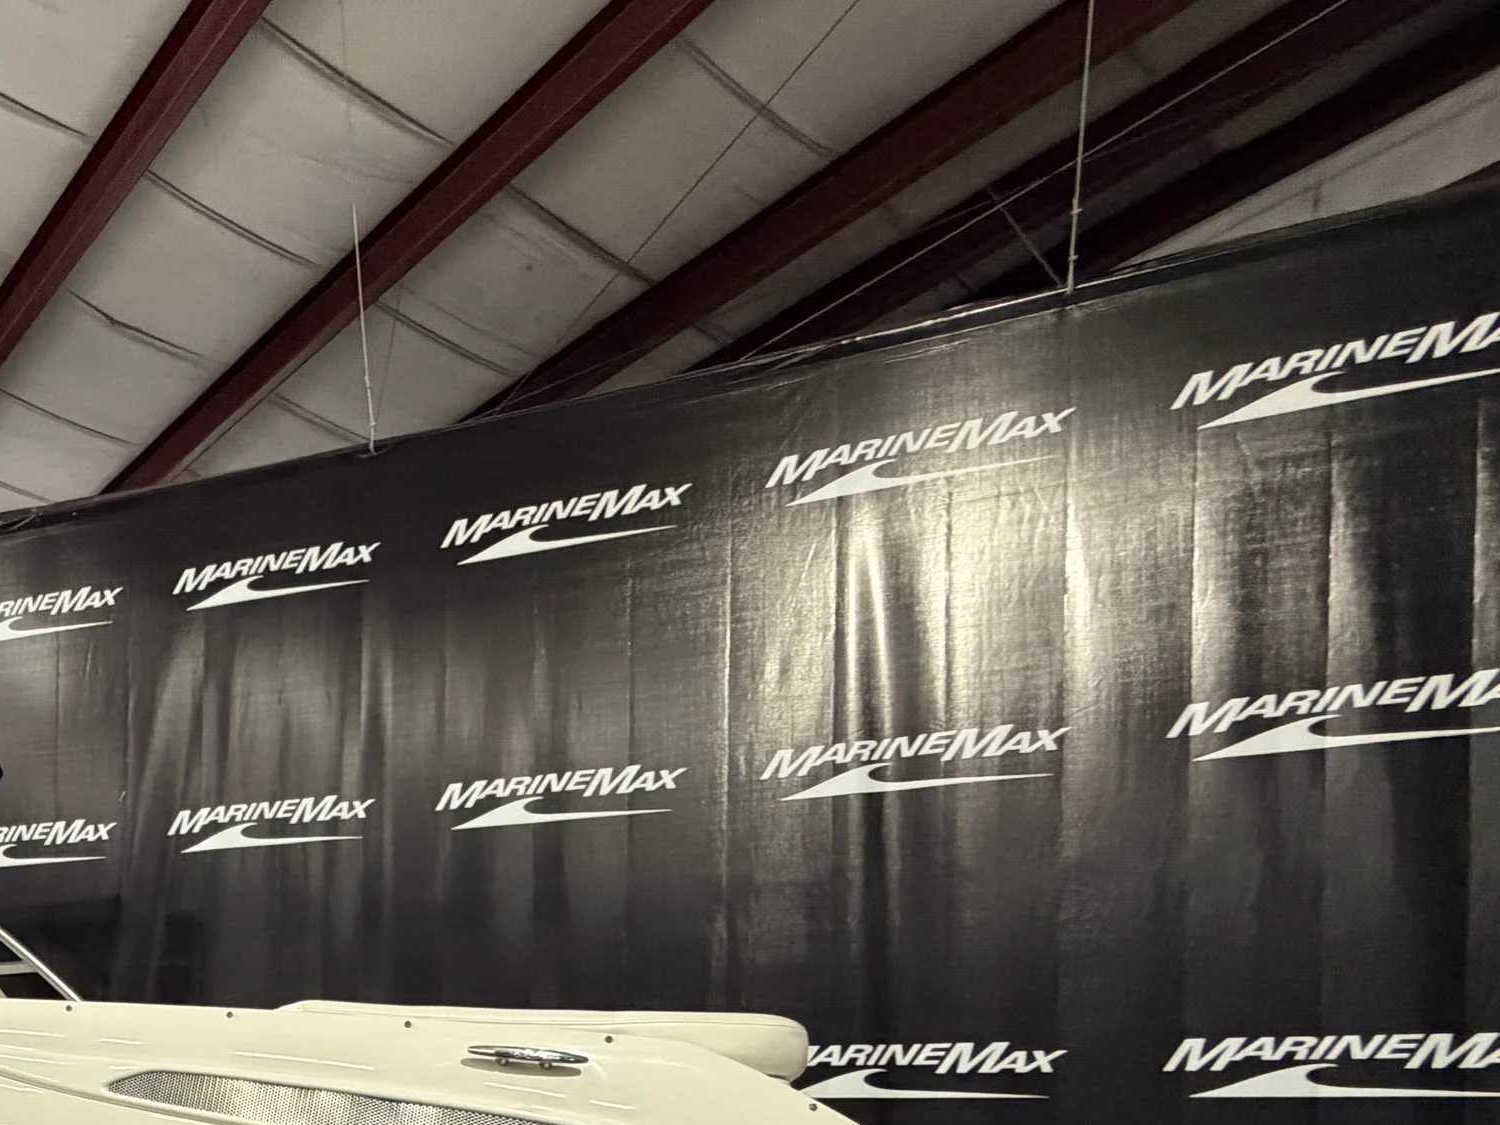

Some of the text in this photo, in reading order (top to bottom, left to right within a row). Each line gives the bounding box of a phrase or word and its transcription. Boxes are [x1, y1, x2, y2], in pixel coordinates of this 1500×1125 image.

[1170, 311, 1500, 410] MARINEM
[764, 406, 1077, 489] MARINEMAX
[439, 482, 694, 549] MARINEMAX
[171, 541, 382, 595] MARINEMAX
[1165, 667, 1500, 739] MARINEM
[759, 723, 1073, 781] MARINEMAX
[167, 796, 376, 836] MARINEMAX
[434, 764, 689, 812] MARINEMAX
[1161, 1031, 1500, 1072] MARINEM
